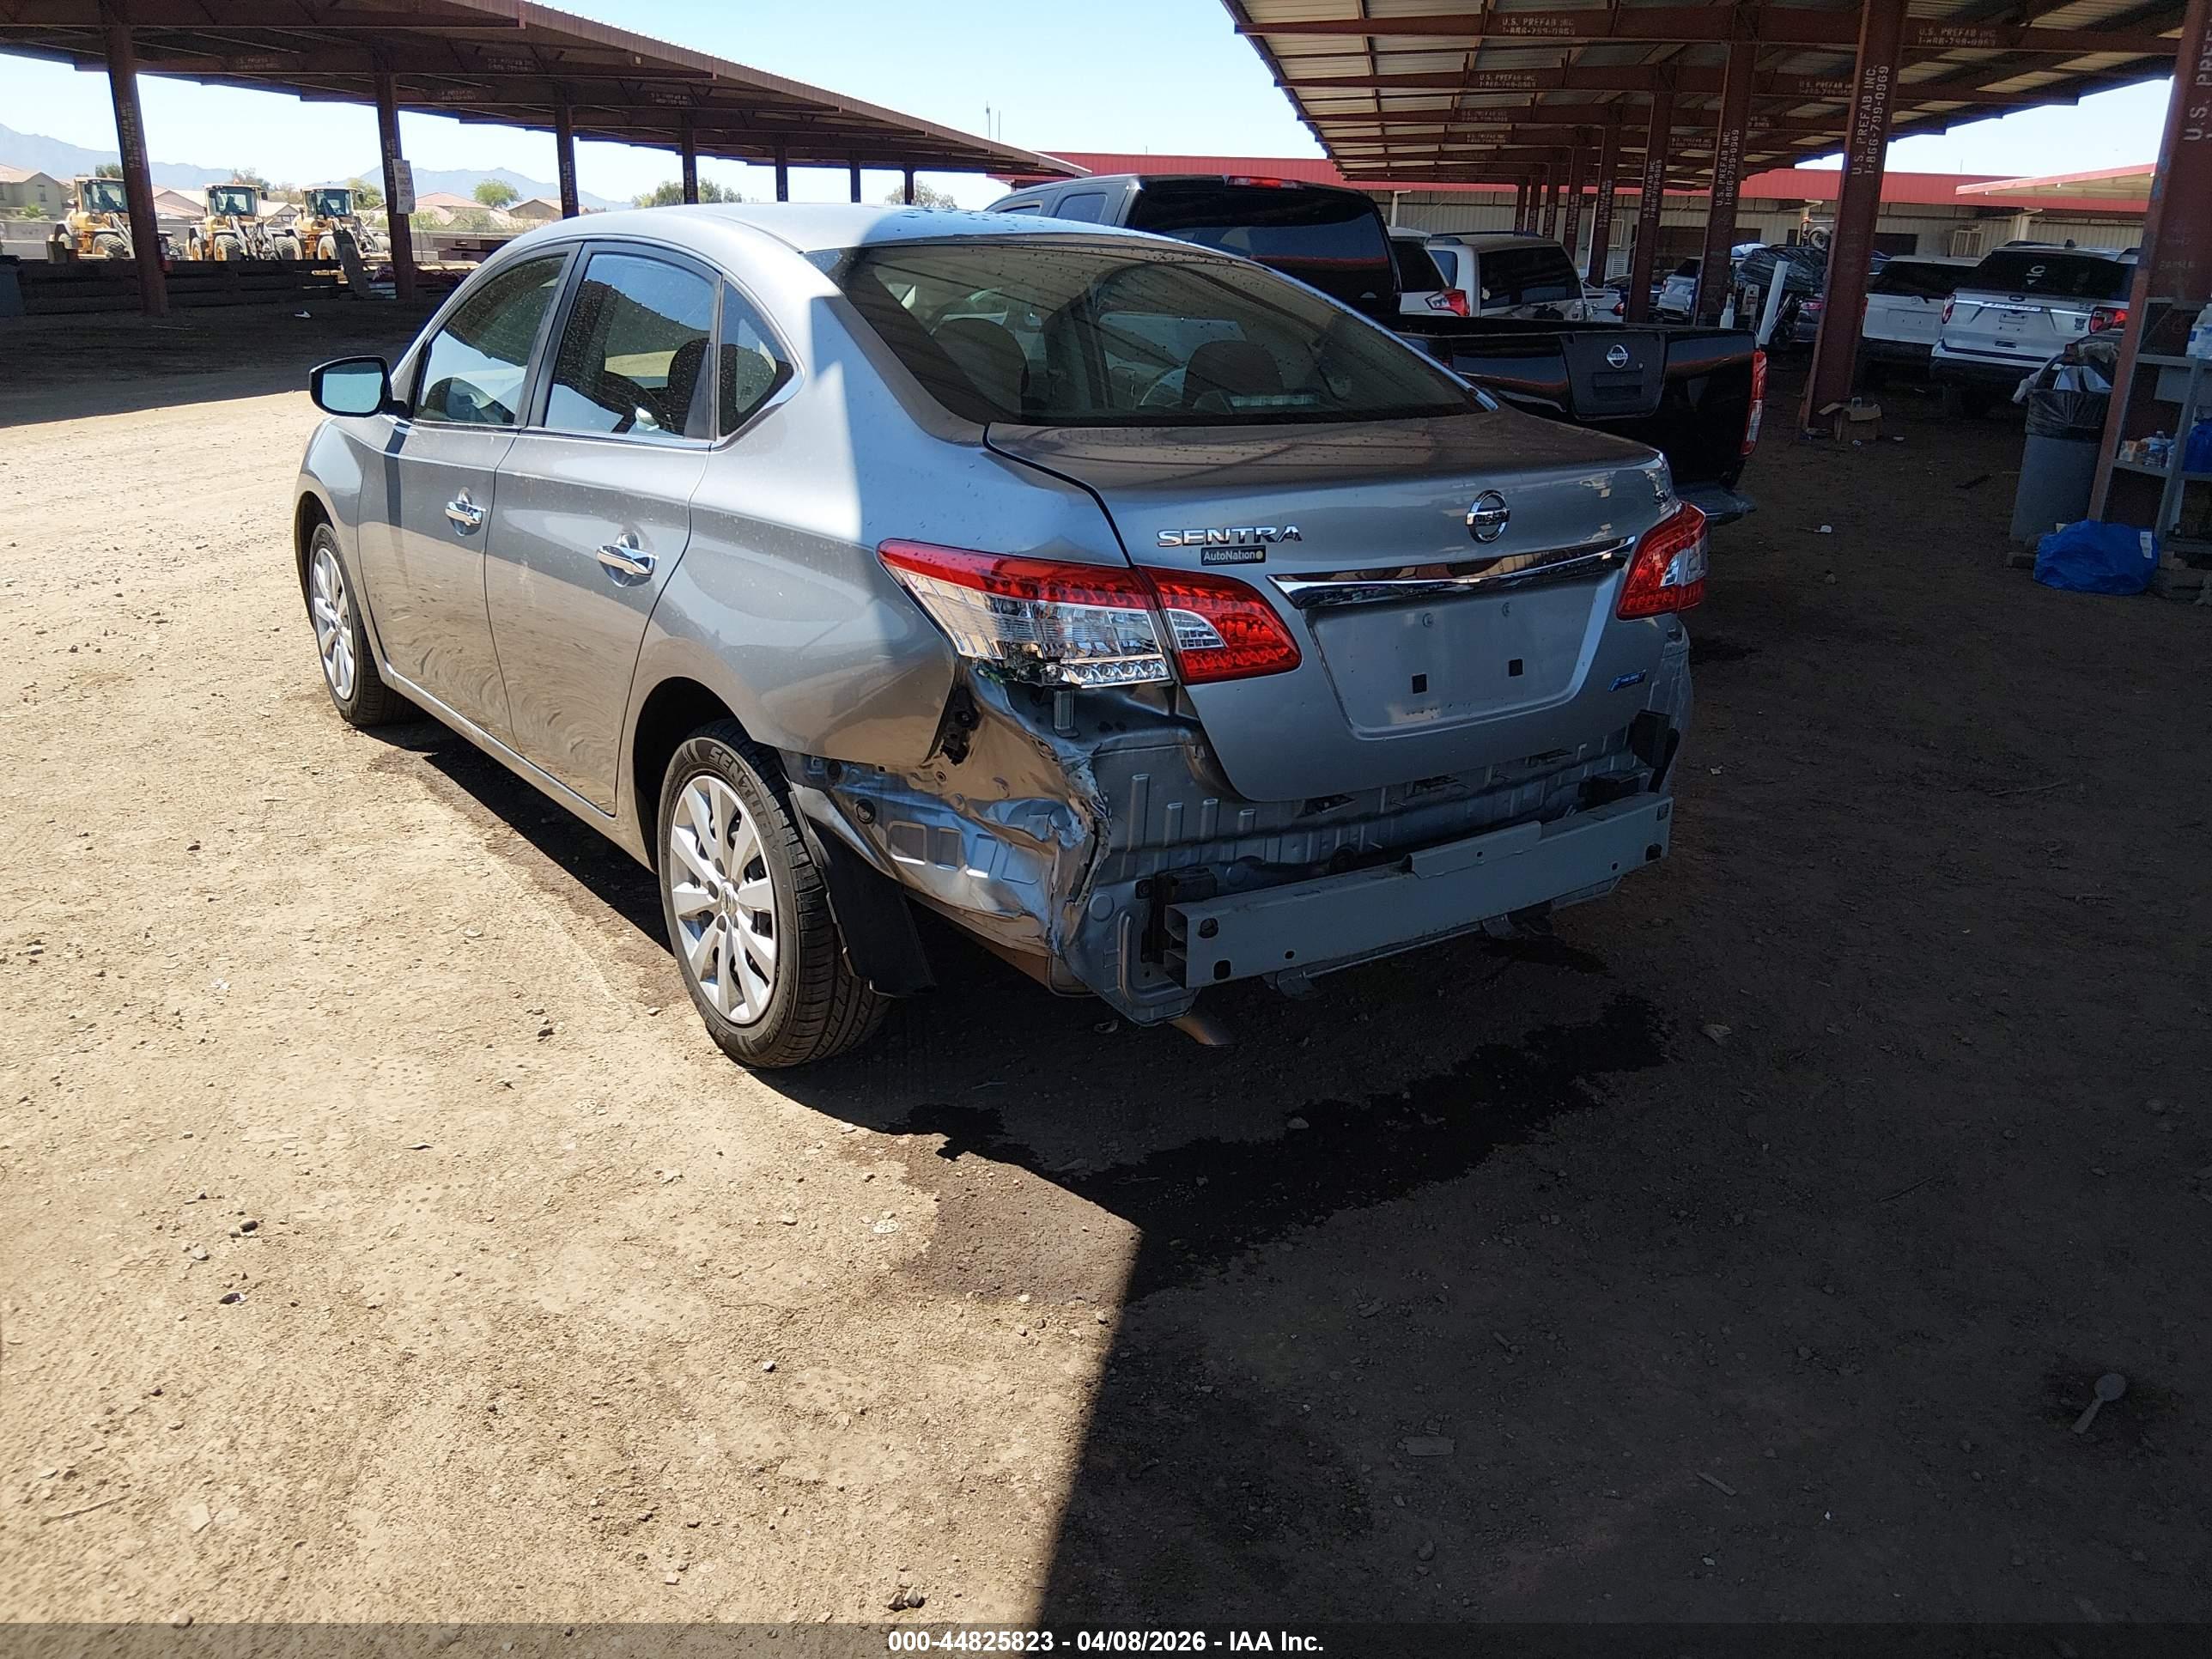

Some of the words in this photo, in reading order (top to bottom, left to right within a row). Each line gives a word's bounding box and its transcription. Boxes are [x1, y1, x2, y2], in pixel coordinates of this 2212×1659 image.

[2196, 17, 2212, 86] PREF
[1864, 64, 1877, 88] INC.
[1856, 95, 1873, 144] PREFAB
[1864, 65, 1889, 174] 1-866-799-0969
[2184, 100, 2211, 141] U.S.
[1718, 149, 1729, 185] PREFAB
[1852, 151, 1865, 175] U.S.
[1157, 525, 1303, 548] SENTRA
[1203, 550, 1255, 562] AutoNation
